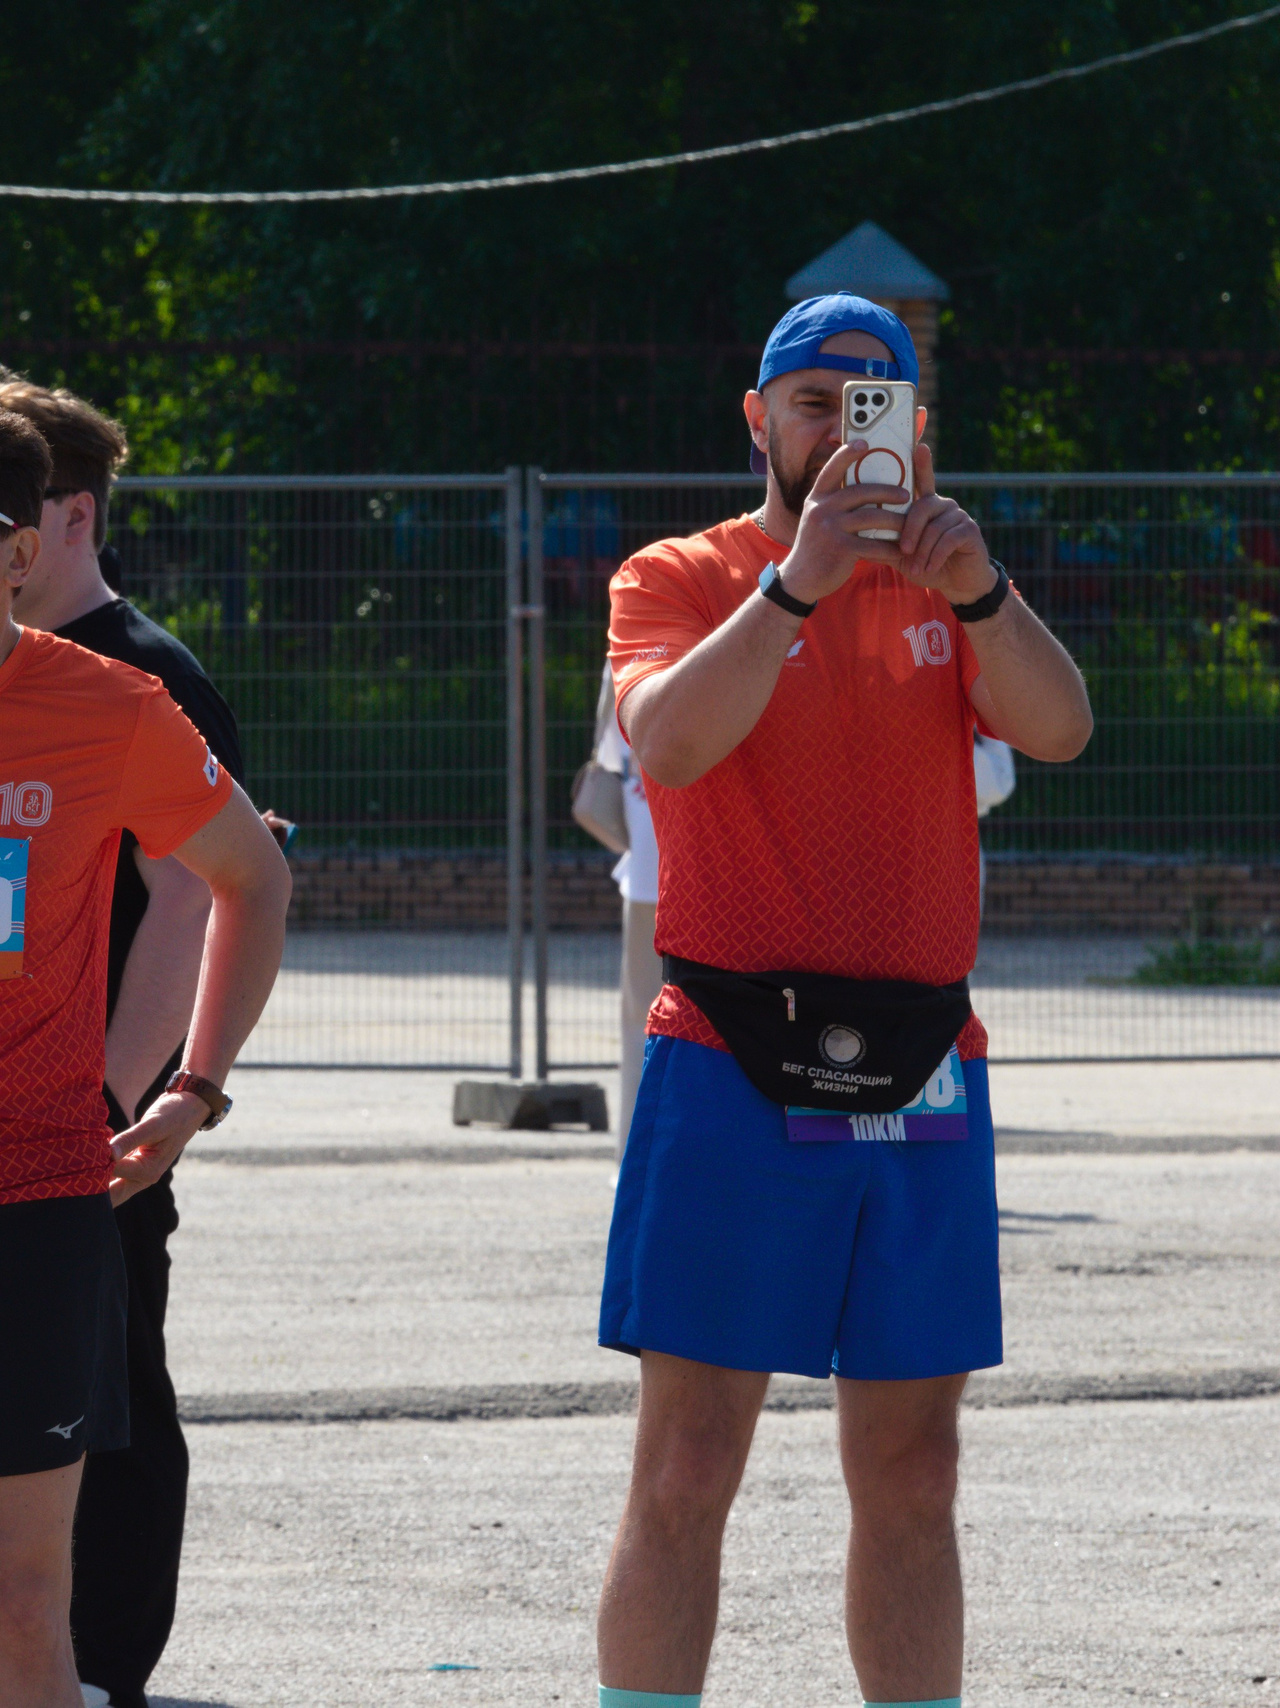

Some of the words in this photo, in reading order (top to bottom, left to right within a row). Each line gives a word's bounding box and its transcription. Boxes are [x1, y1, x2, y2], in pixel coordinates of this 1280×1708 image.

[902, 619, 952, 667] 10
[781, 1062, 804, 1076] БЕГ,
[807, 1067, 893, 1087] СПАСАЮЩИЙ
[811, 1079, 859, 1094] ЖИЗНИ
[848, 1114, 907, 1141] 10KM
